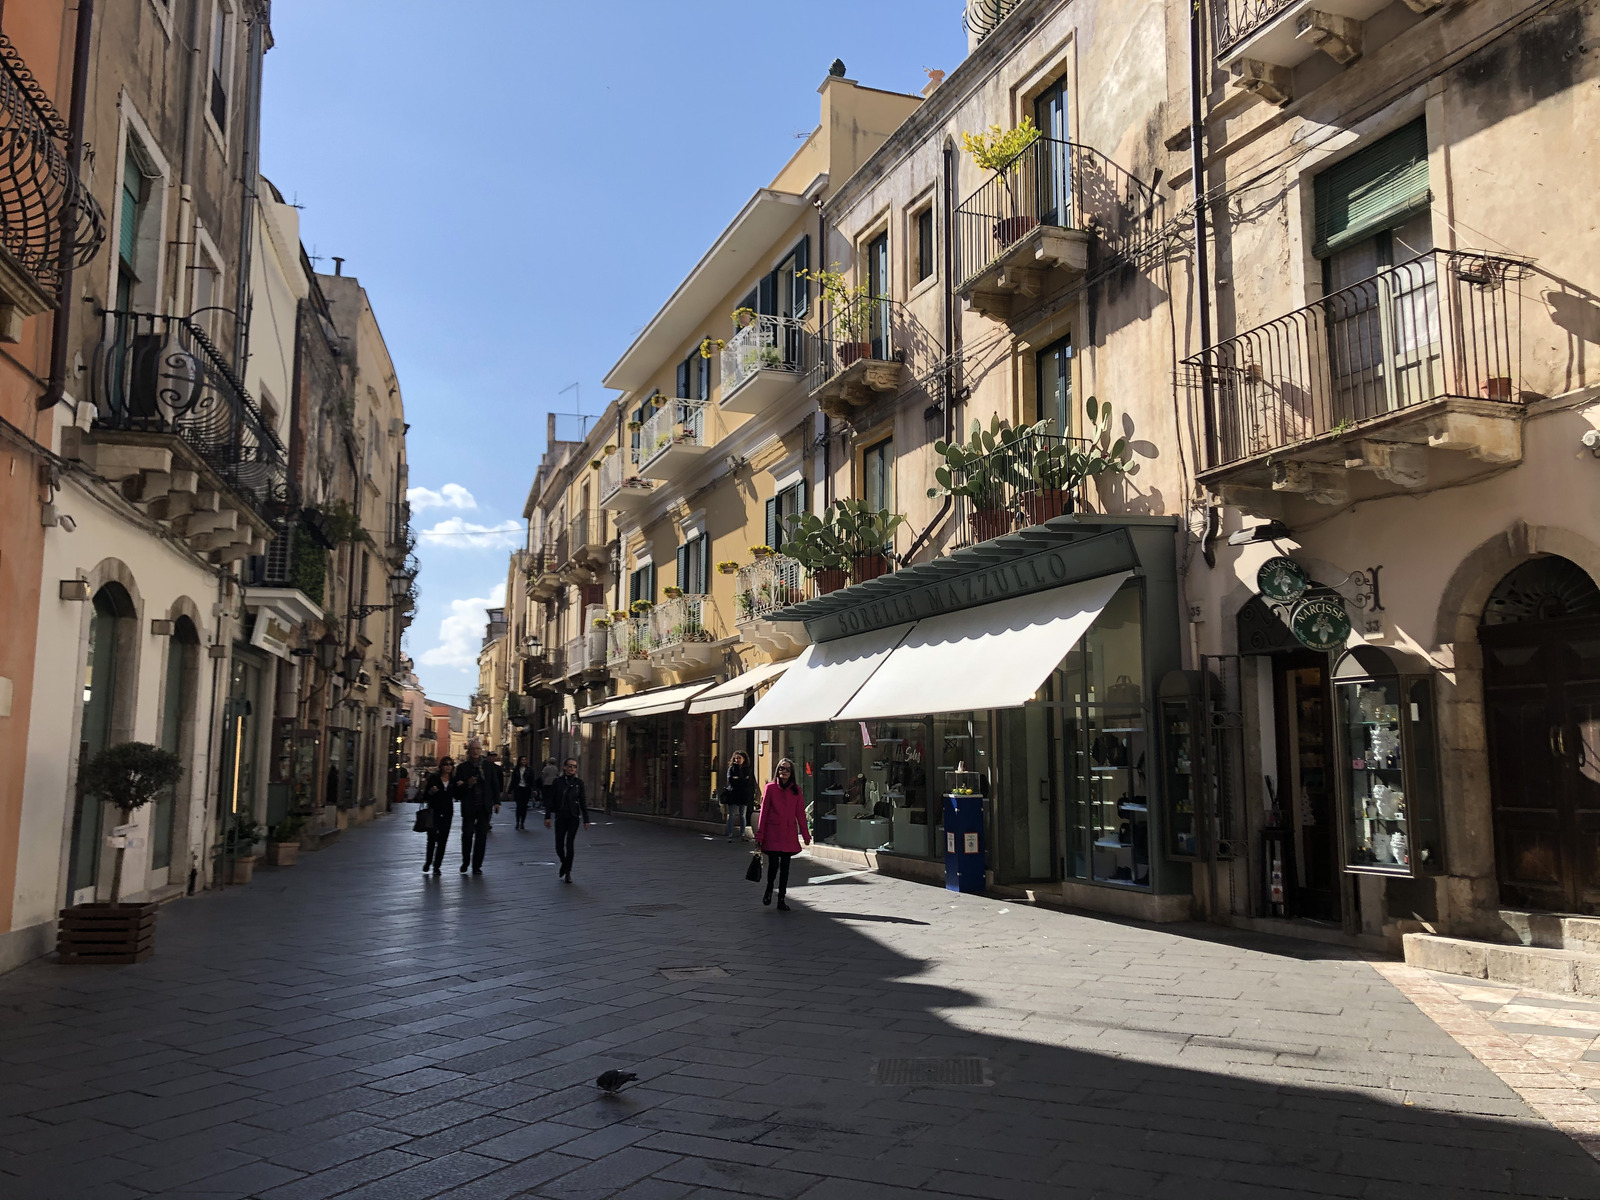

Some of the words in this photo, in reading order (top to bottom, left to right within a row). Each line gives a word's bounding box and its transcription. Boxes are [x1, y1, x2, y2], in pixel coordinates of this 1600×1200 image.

[1259, 559, 1298, 580] NARCISSE
[838, 595, 917, 634] SORELLE
[925, 553, 1067, 611] MAZZULLO
[1296, 603, 1345, 624] NARCISSE
